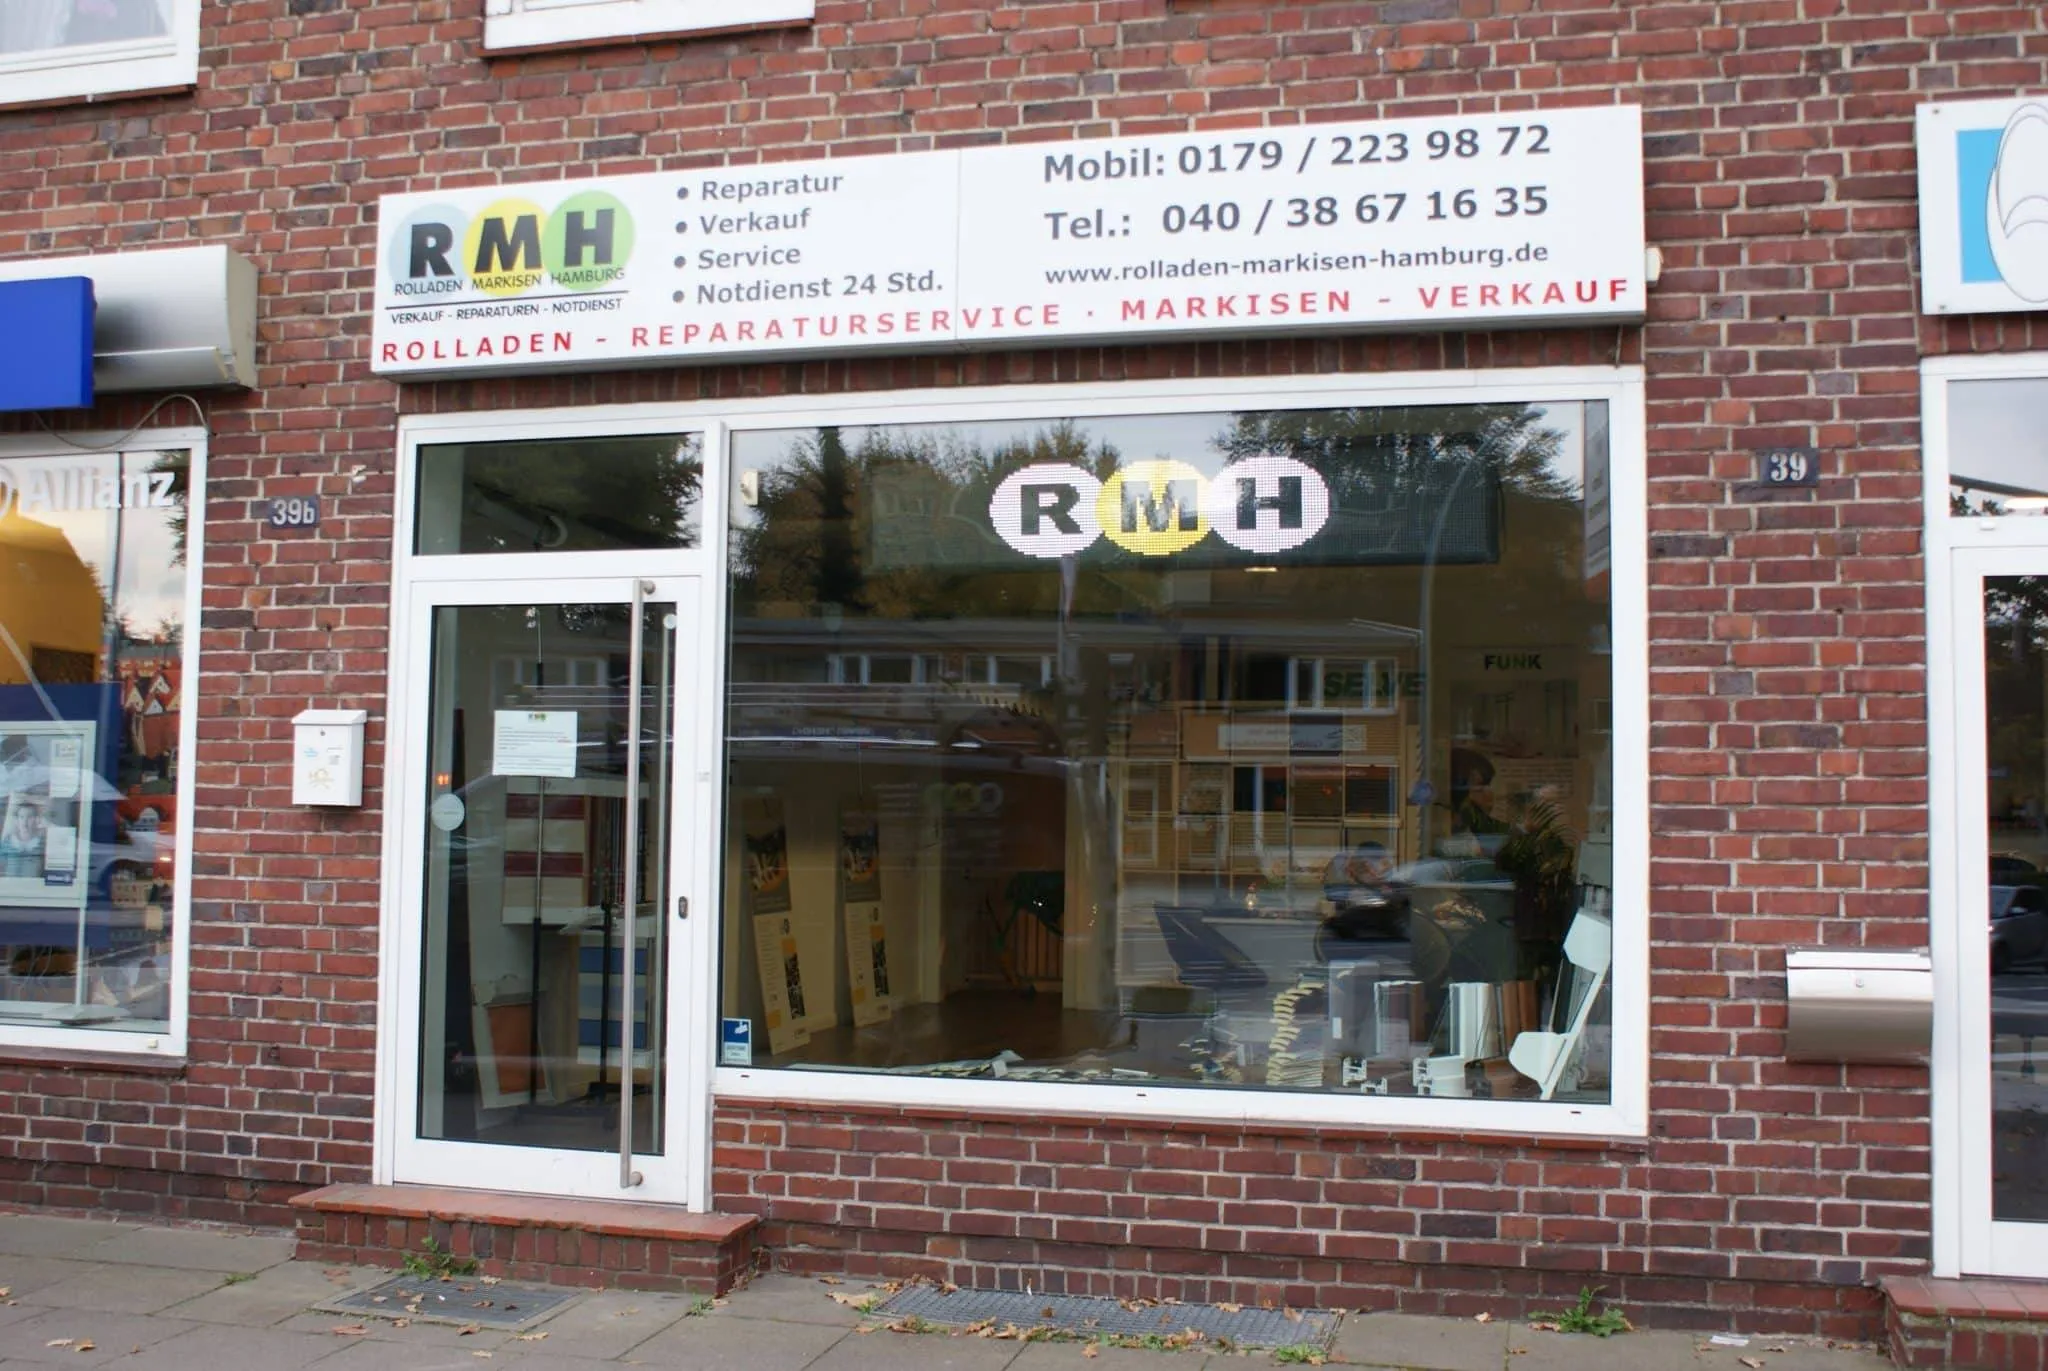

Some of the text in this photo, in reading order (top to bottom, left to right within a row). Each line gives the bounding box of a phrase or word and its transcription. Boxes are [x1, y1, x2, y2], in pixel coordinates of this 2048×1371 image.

[1045, 148, 1164, 183] Mobil:
[1179, 141, 1283, 175] 0179
[1332, 133, 1409, 165] 223
[1427, 129, 1480, 161] 98
[1498, 125, 1551, 156] 72
[702, 174, 844, 203] Reparatur
[701, 207, 811, 235] Verkauf
[1045, 209, 1130, 240] Tel.:
[1163, 202, 1241, 234] 040
[1287, 197, 1339, 228] 38
[1356, 193, 1407, 224] 67
[1428, 189, 1477, 221] 16
[1496, 186, 1548, 217] 35
[408, 207, 615, 279] RMH
[699, 246, 801, 270] Service
[1046, 243, 1548, 284] www.rolladen-markisen-hamburg.de
[395, 266, 625, 296] ROLLADEN MARKISEN HAMBURG
[698, 270, 942, 304] Notdienst 24 Std.
[381, 332, 573, 361] ROLLADEN
[632, 304, 1061, 348] REPARATURSERVICE
[1121, 291, 1351, 321] MARKISEN
[1420, 278, 1628, 309] VERKAUF
[392, 310, 444, 324] VERKAUF
[457, 303, 539, 319] REPARATUREN
[552, 298, 622, 313] NOTDIENST
[1770, 452, 1808, 482] 39
[25, 465, 177, 510] Allianz
[270, 497, 316, 527] 39b
[1020, 475, 1303, 536] RMH
[1484, 653, 1543, 671] FUNK
